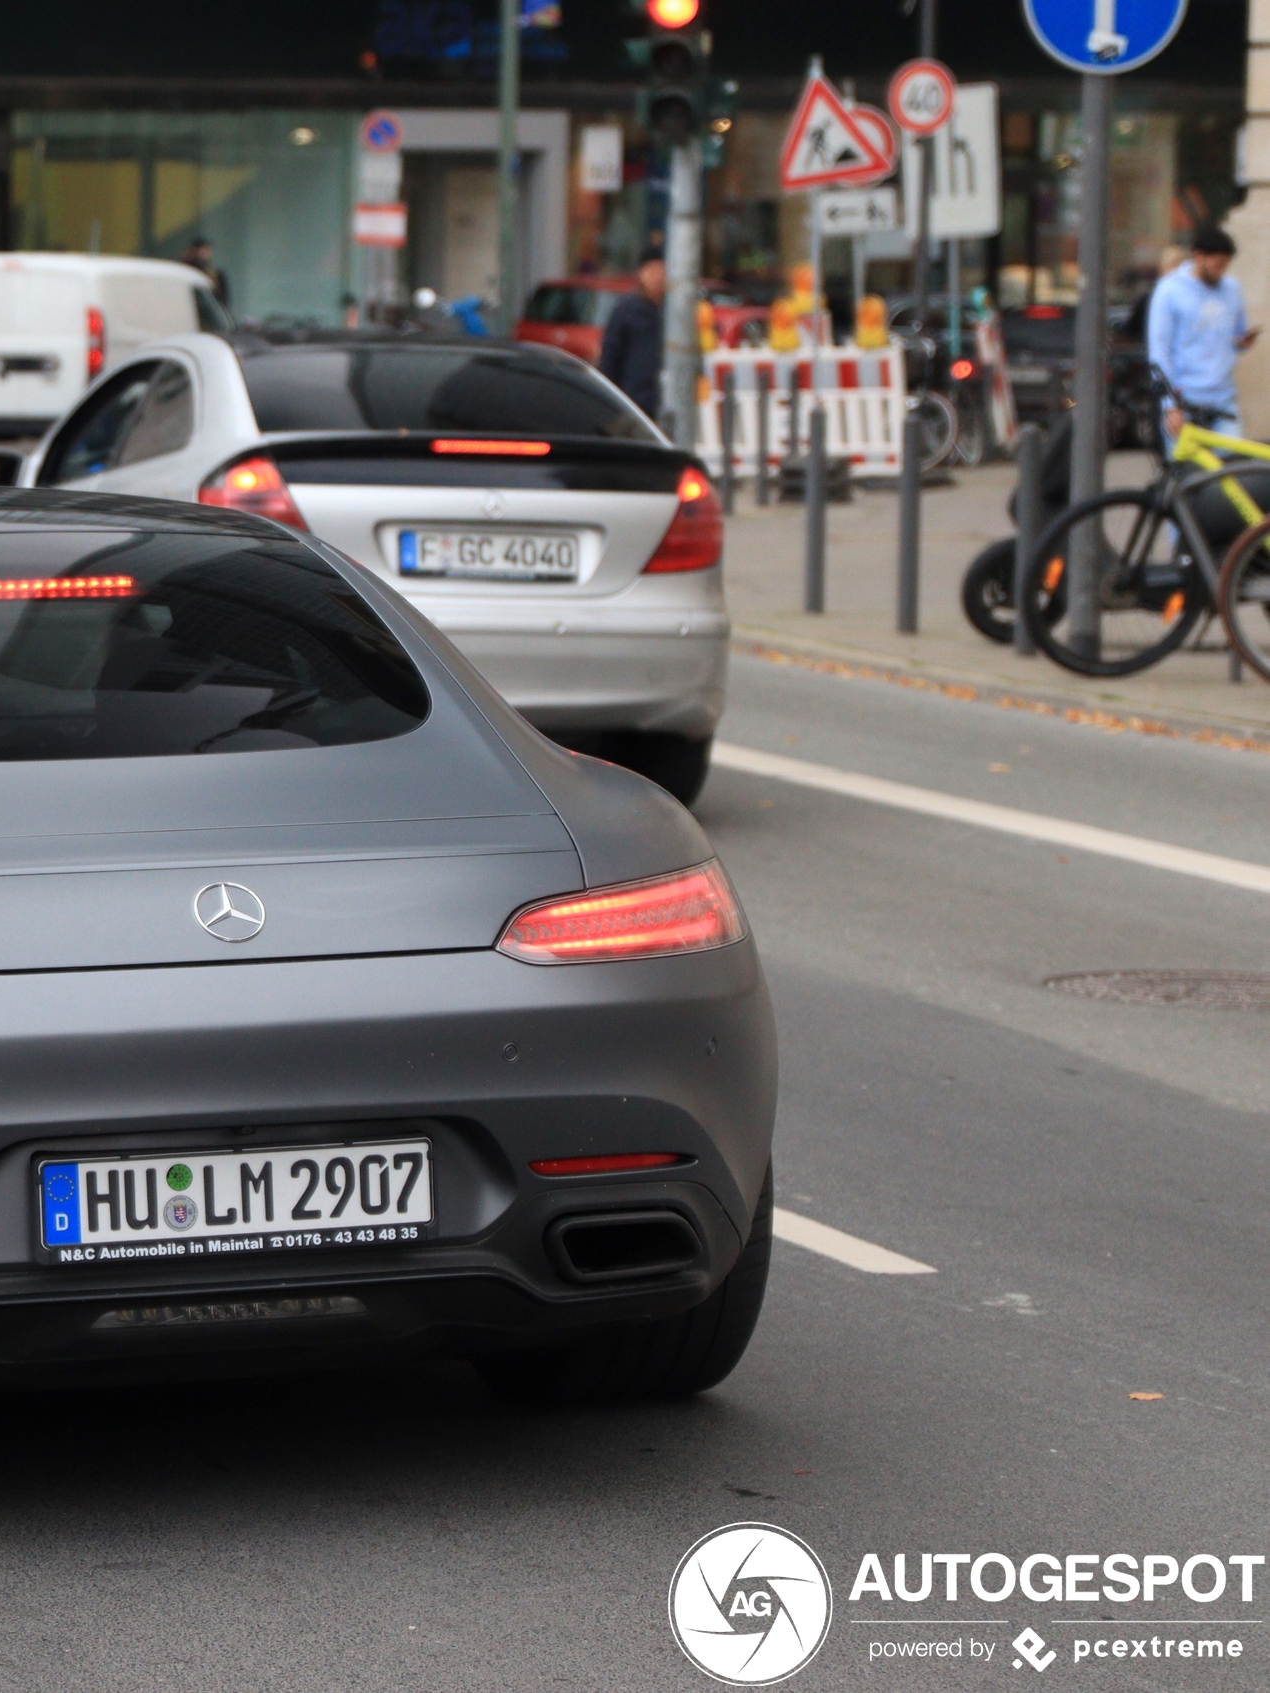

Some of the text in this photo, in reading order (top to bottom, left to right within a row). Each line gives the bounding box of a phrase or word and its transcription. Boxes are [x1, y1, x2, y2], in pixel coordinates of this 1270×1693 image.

[906, 82, 943, 114] 40
[420, 536, 573, 569] F GC 4040
[85, 1168, 158, 1233] HU
[202, 1160, 274, 1226] LM
[290, 1151, 423, 1221] 2907
[55, 1213, 69, 1232] D
[60, 1247, 96, 1262] N&C
[99, 1241, 186, 1260] Automobile
[189, 1241, 204, 1254] in
[207, 1236, 264, 1253] Maintal
[334, 1230, 353, 1244] 43
[356, 1229, 375, 1242] 43
[378, 1228, 397, 1241] 48
[400, 1227, 418, 1240] 35
